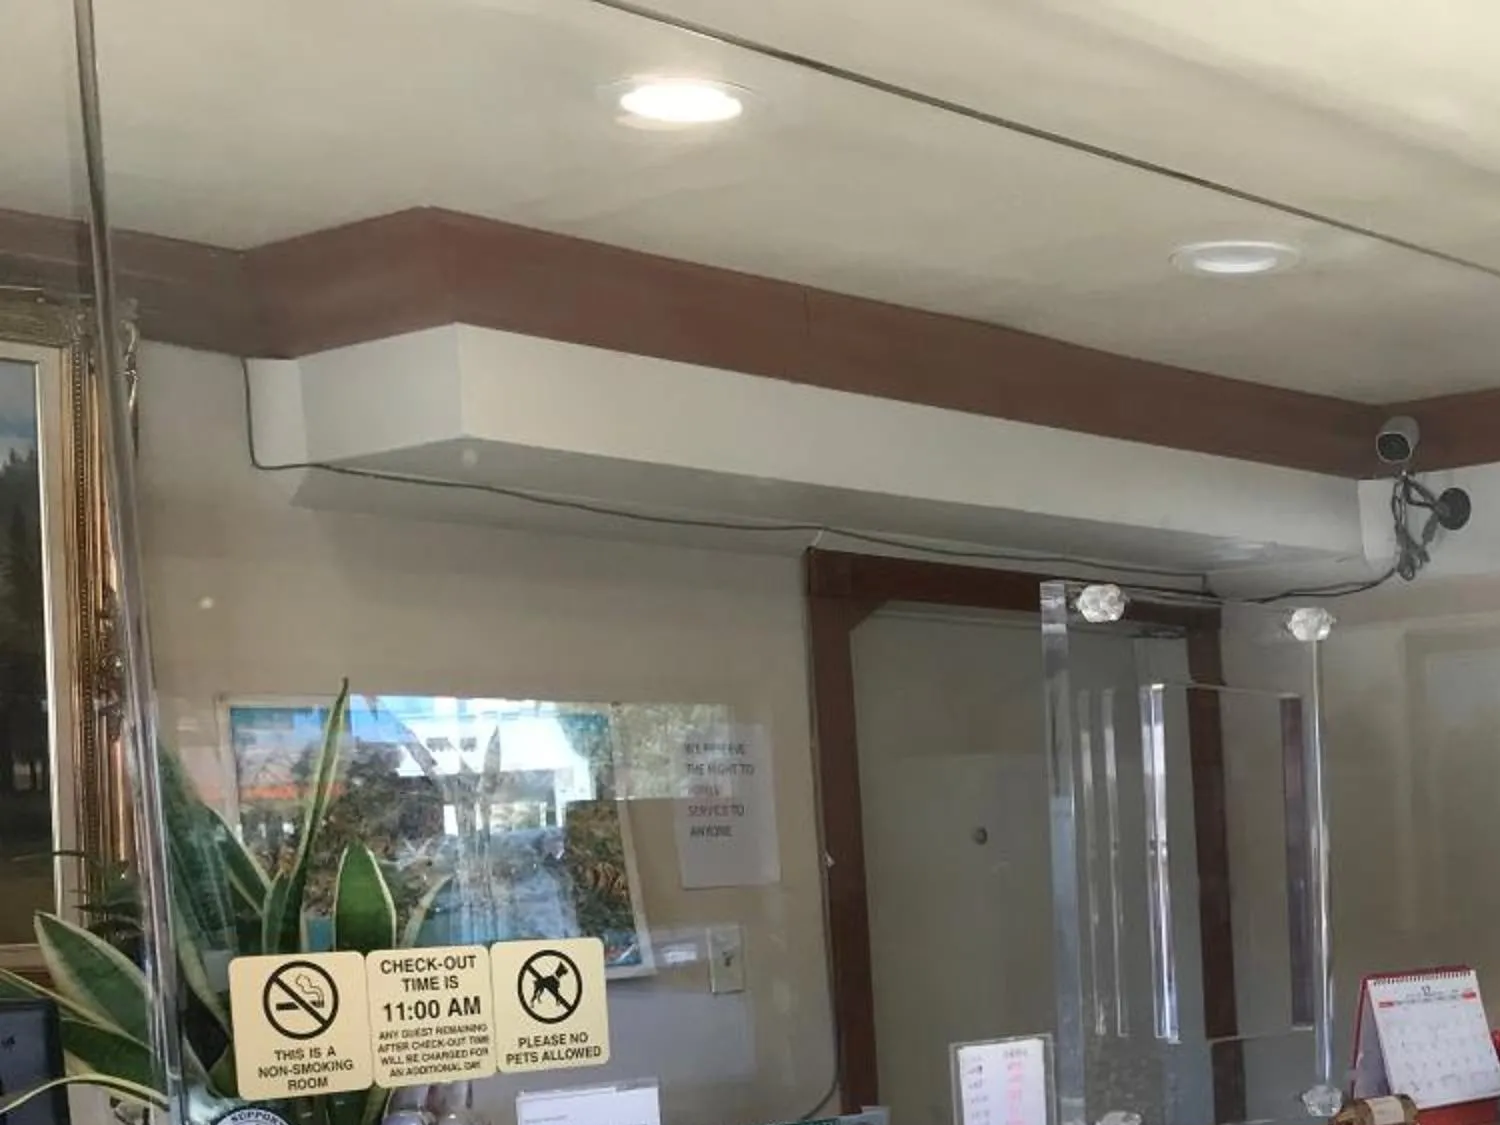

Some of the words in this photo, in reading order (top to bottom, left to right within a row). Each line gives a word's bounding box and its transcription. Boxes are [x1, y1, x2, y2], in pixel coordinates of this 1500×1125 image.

[688, 804, 730, 817] SERVICE
[731, 804, 745, 817] TO
[380, 955, 476, 974] CHECK-OUT
[401, 976, 440, 992] TIME
[445, 975, 459, 989] IS
[384, 1000, 440, 1022] 11:00
[448, 996, 481, 1017] AM
[379, 1030, 398, 1040] ANY
[401, 1027, 433, 1038] GUEST
[436, 1023, 488, 1034] REMAINING
[518, 1033, 567, 1049] PLEASE
[569, 1031, 588, 1045] NO
[378, 1041, 409, 1053] AFTER
[411, 1036, 466, 1050] CHECK-OUT
[469, 1034, 489, 1045] TIME
[274, 1047, 305, 1061] THIS
[309, 1047, 322, 1059] IS
[327, 1045, 337, 1056] A
[381, 1055, 404, 1066] WILL
[406, 1053, 418, 1063] BE
[421, 1049, 469, 1062] CHARGED
[469, 1046, 489, 1056] FOR
[506, 1051, 539, 1065] PETS
[541, 1045, 601, 1062] ALLOWED
[257, 1058, 354, 1079] NON-SMOKING
[389, 1067, 405, 1078] AN
[406, 1062, 462, 1076] ADDITIONAL
[287, 1076, 328, 1091] ROOM
